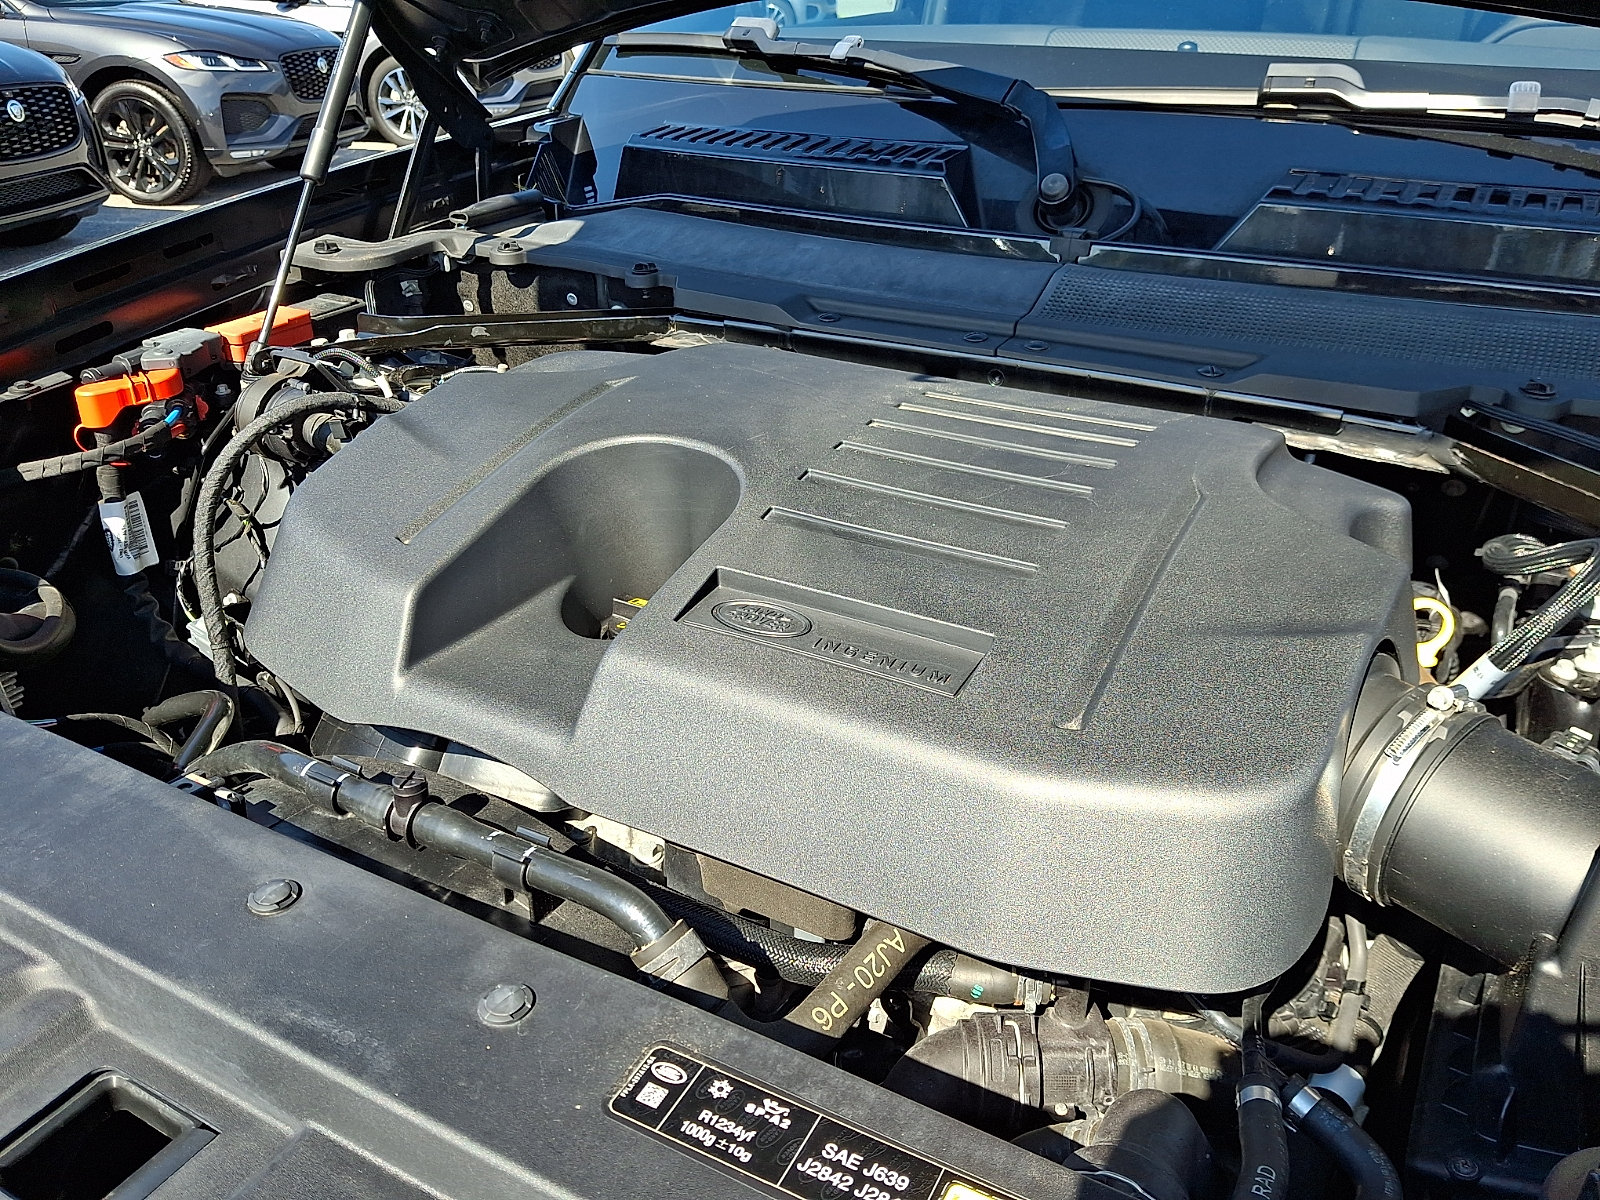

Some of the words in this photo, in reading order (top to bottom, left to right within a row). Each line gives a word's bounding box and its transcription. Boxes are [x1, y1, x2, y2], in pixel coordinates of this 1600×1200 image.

[812, 637, 952, 686] INGENIUM
[853, 927, 906, 990] AJ20
[811, 991, 849, 1031] P6
[680, 1120, 717, 1147] 1000g
[697, 1109, 757, 1142] R1234yf
[796, 1157, 854, 1192] J2842
[821, 1142, 864, 1171] SAE
[862, 1162, 910, 1192] J639
[1251, 1165, 1276, 1200] RAD
